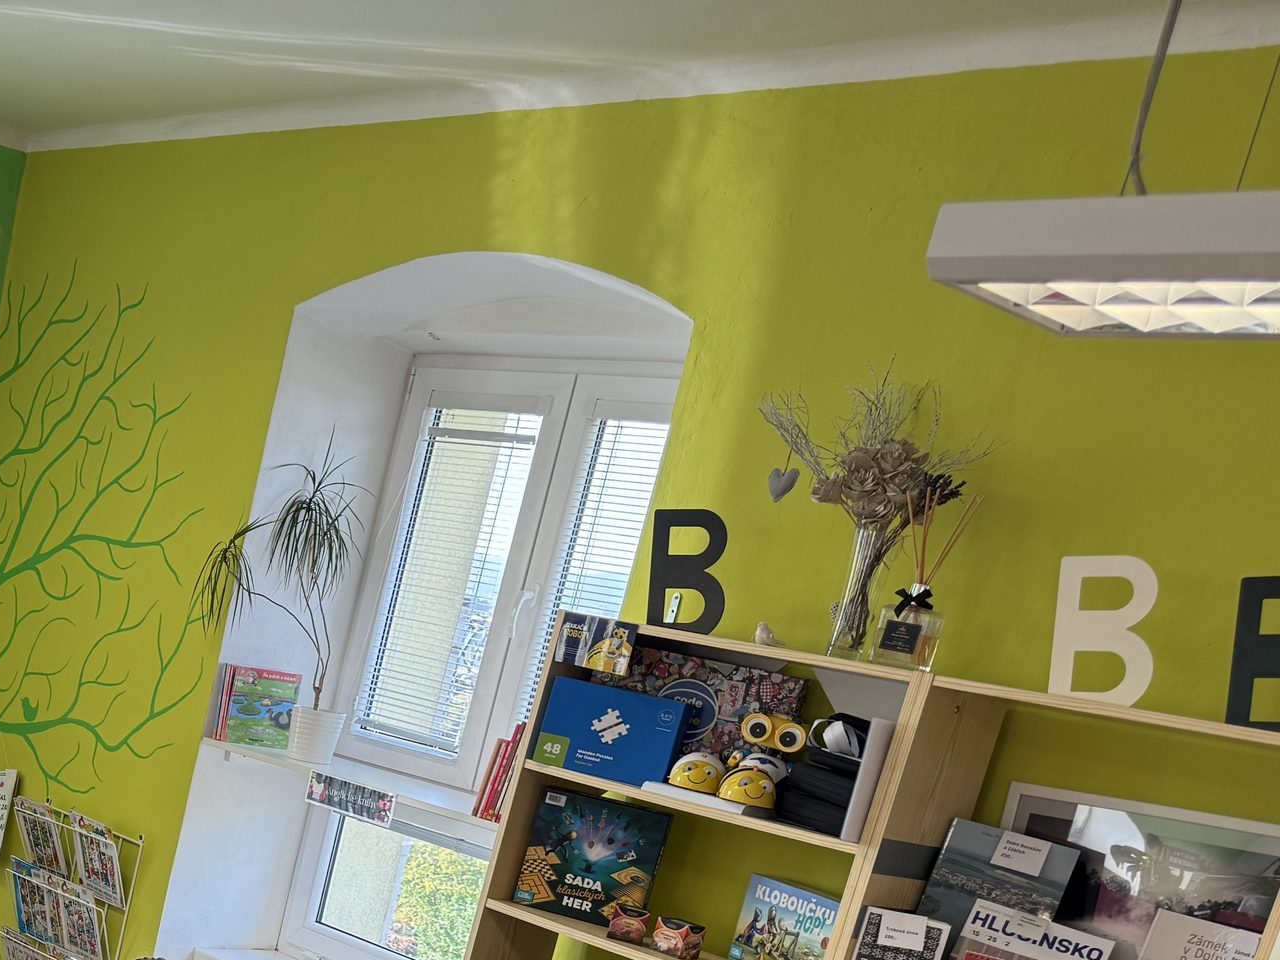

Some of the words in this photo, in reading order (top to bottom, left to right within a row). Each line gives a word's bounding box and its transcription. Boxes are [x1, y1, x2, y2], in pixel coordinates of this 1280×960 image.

[647, 508, 728, 635] B
[1048, 554, 1159, 707] B
[543, 742, 561, 755] 48
[564, 873, 602, 892] SADA
[555, 885, 607, 901] klasických
[562, 897, 592, 912] HER
[1183, 947, 1191, 955] v
